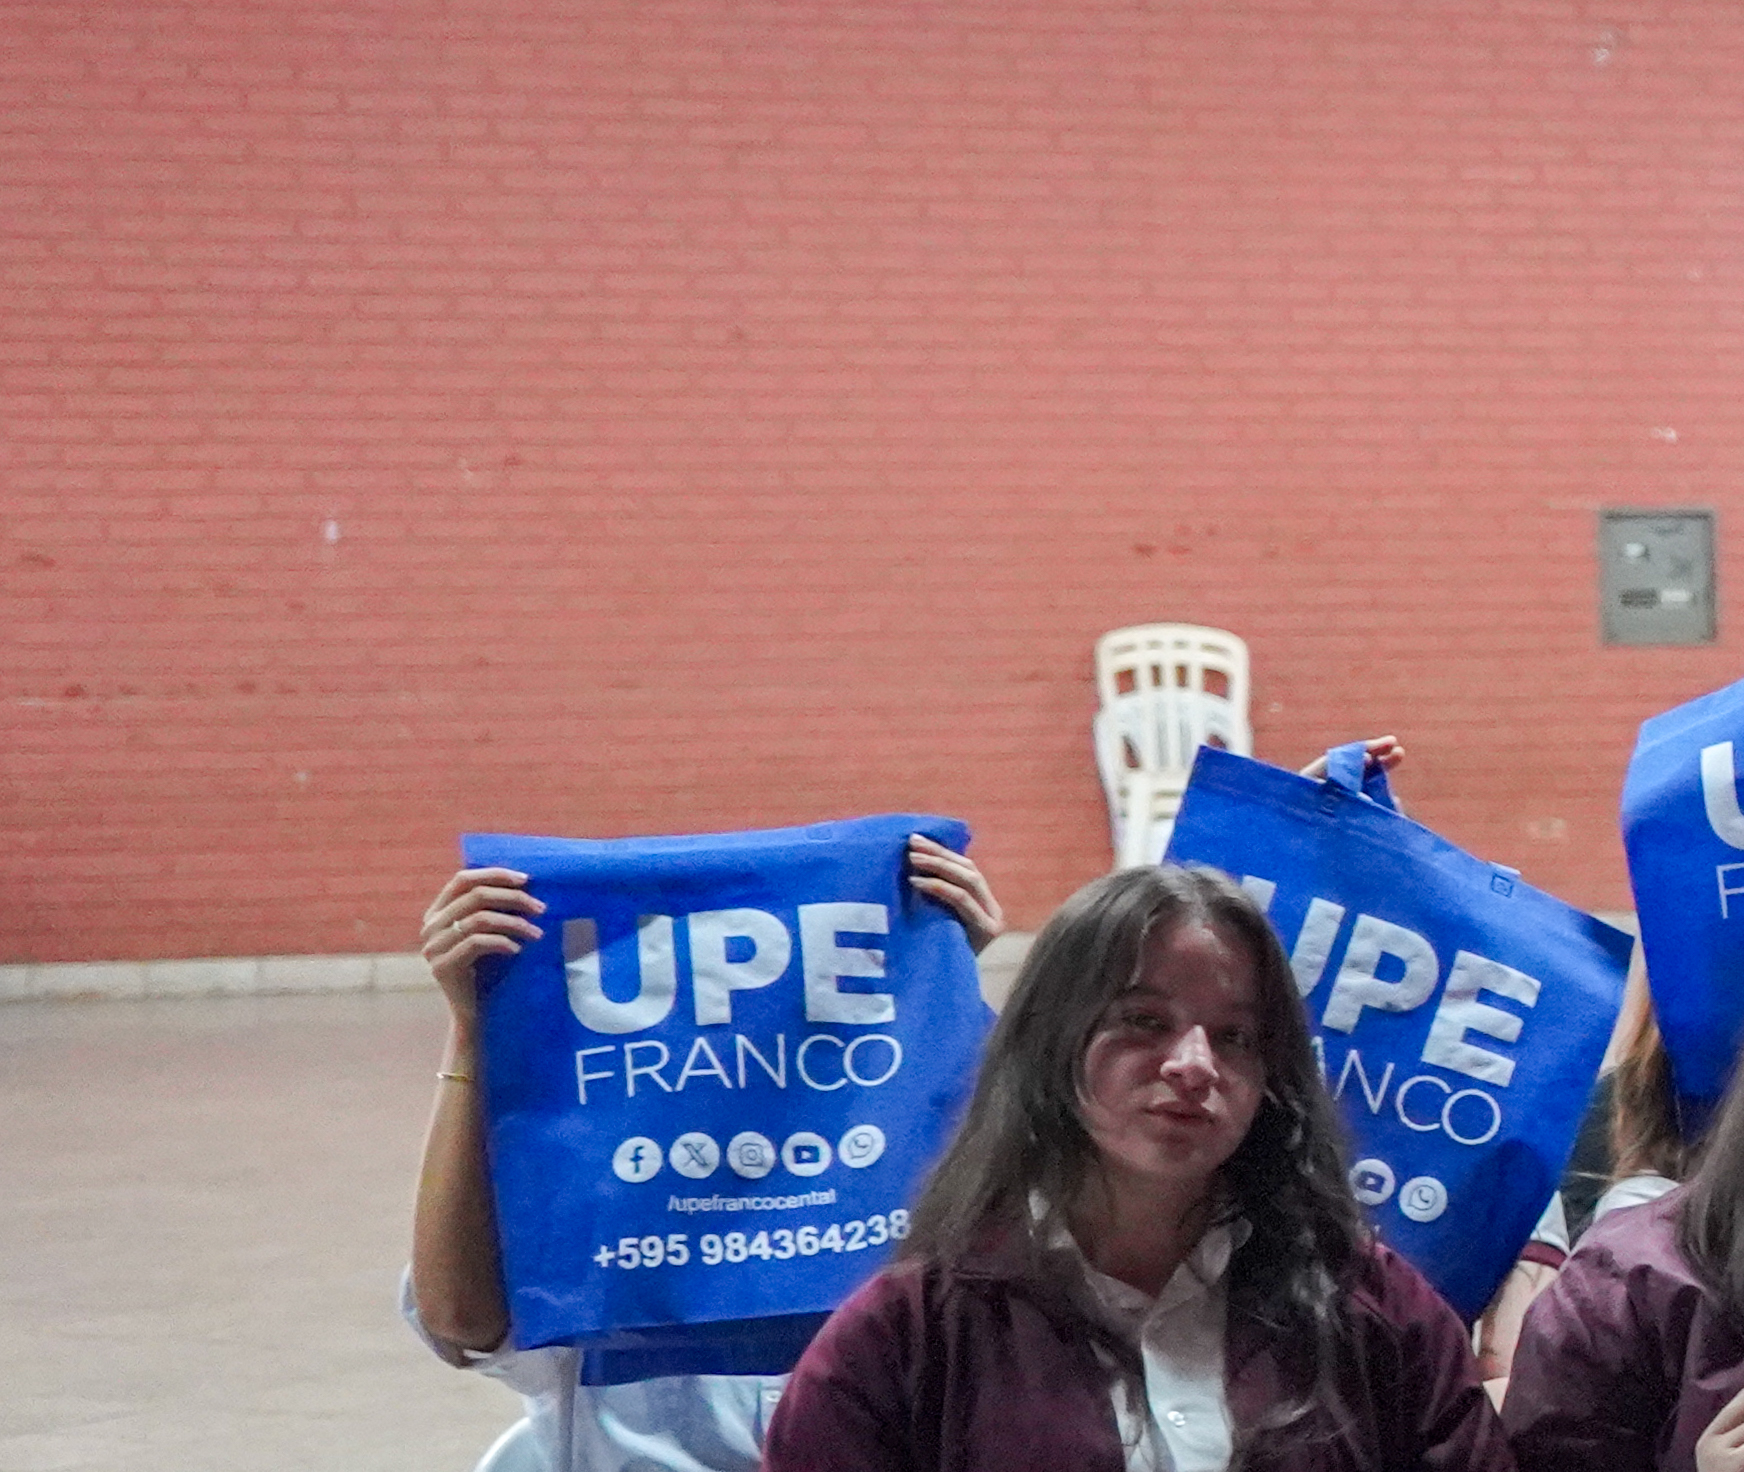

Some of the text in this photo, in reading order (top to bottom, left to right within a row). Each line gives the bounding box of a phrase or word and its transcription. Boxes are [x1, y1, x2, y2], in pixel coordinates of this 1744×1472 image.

[563, 902, 896, 1034] UPE
[575, 1033, 902, 1105] FRANCO
[594, 1209, 911, 1270] +595 984364238
